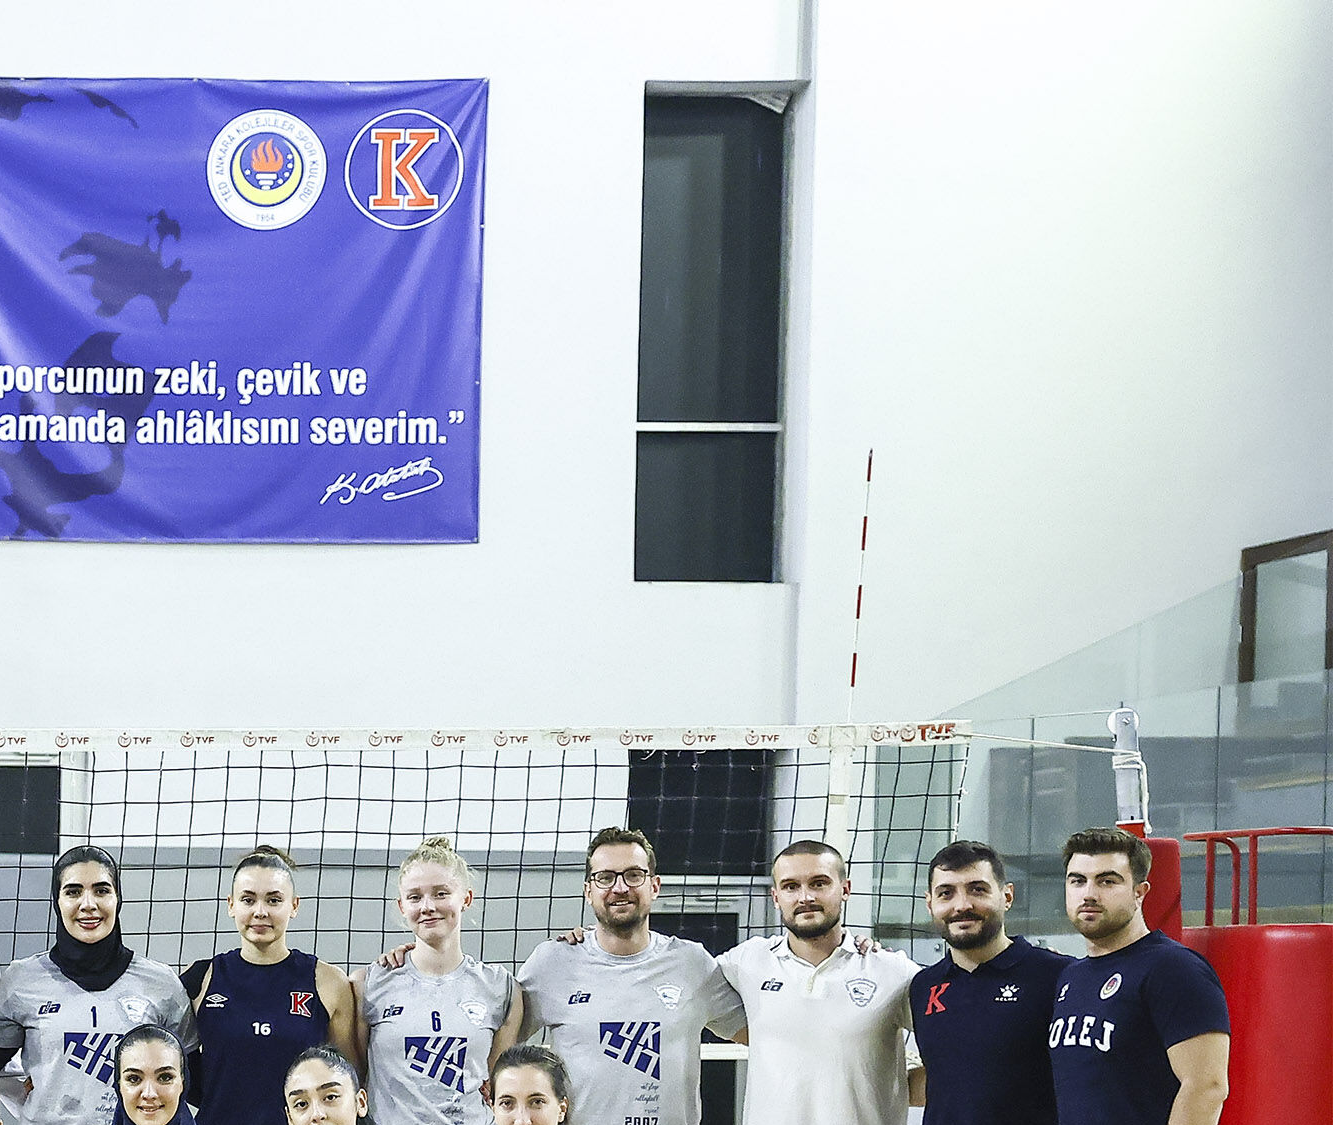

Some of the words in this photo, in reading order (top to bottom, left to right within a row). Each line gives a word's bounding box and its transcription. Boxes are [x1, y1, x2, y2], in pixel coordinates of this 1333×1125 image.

[214, 135, 236, 176] ANKARA
[294, 130, 317, 157] SPOR
[369, 127, 440, 210] K
[215, 181, 236, 203] TED
[153, 360, 227, 401] zeki,
[236, 361, 322, 405] çevik
[329, 366, 367, 396] ve
[136, 409, 300, 445] ahlâklısını
[290, 991, 312, 1017] K
[925, 982, 950, 1015] K
[90, 1006, 97, 1028] 1
[252, 1022, 271, 1036] 16
[432, 1010, 441, 1032] 6
